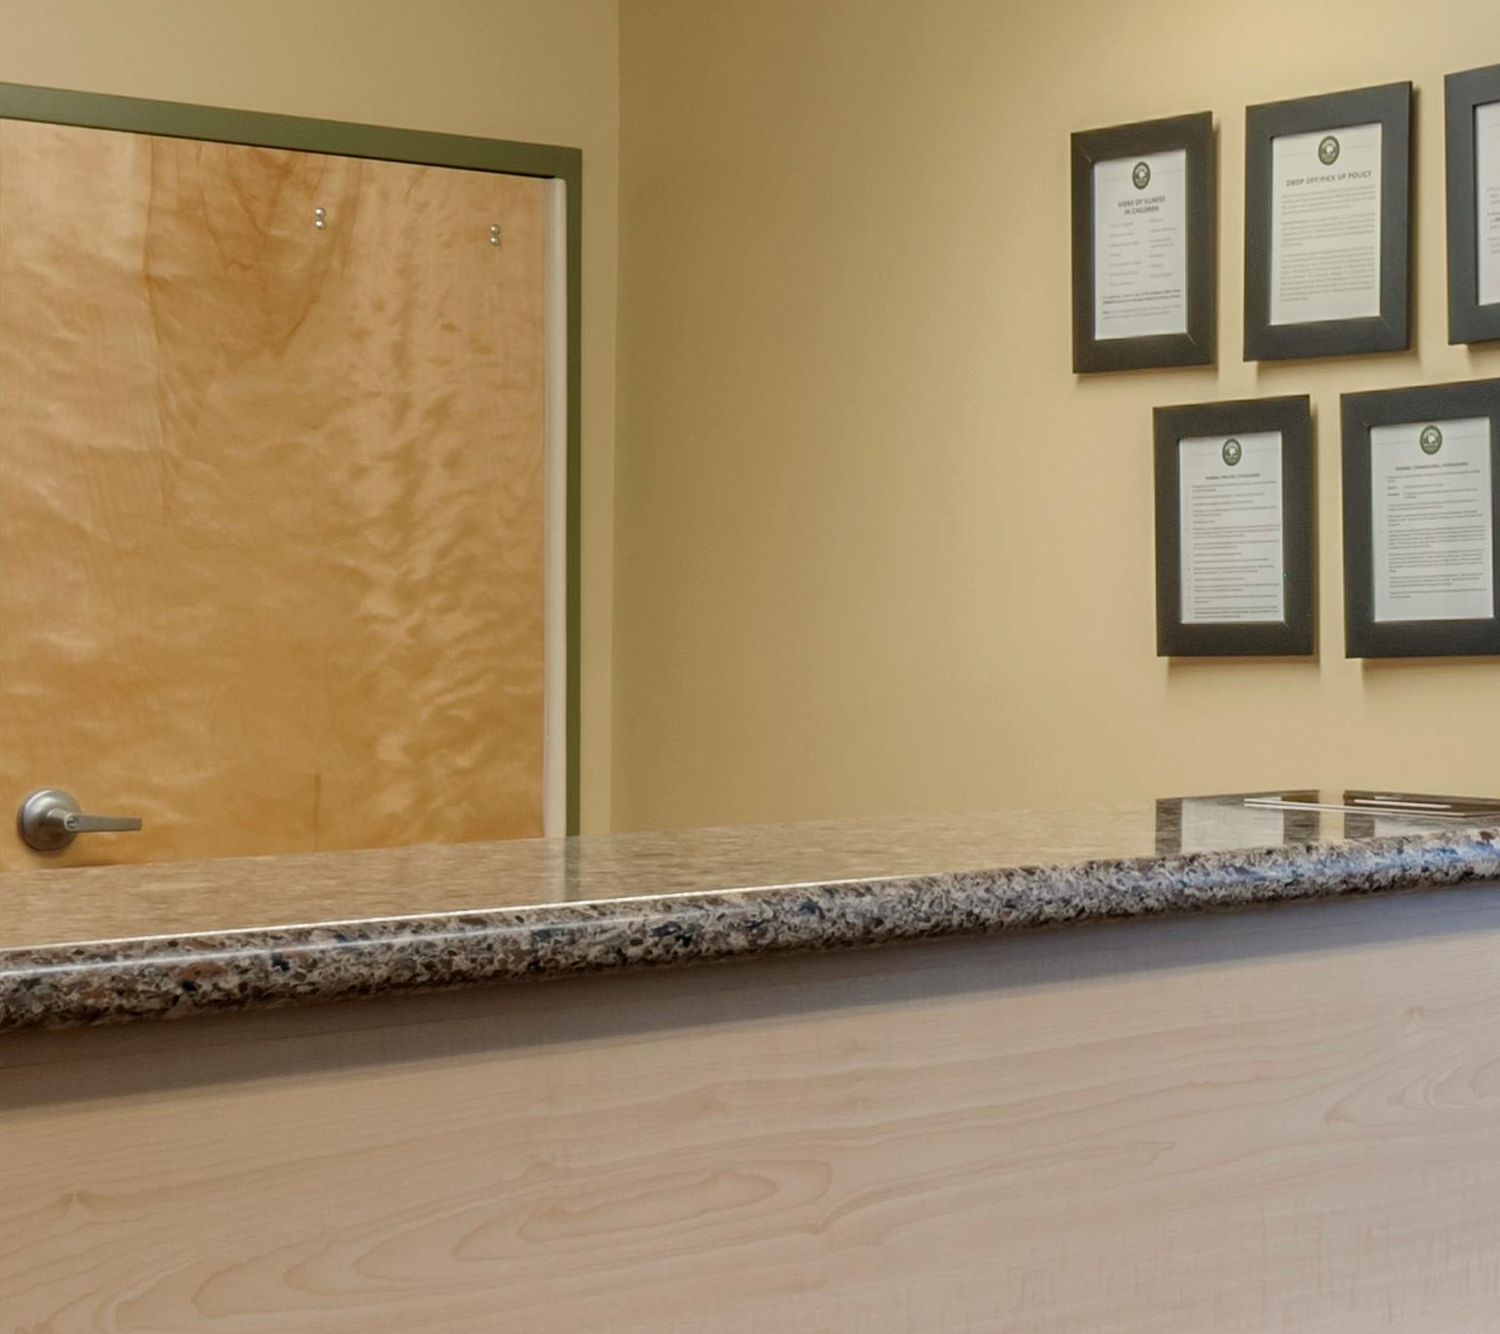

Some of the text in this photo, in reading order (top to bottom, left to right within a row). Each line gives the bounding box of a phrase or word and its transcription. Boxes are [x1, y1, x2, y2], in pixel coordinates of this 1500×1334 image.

[1286, 178, 1304, 187] DROP
[1347, 170, 1372, 179] POLICY
[1118, 200, 1135, 208] SIGNS
[1136, 198, 1144, 206] OF
